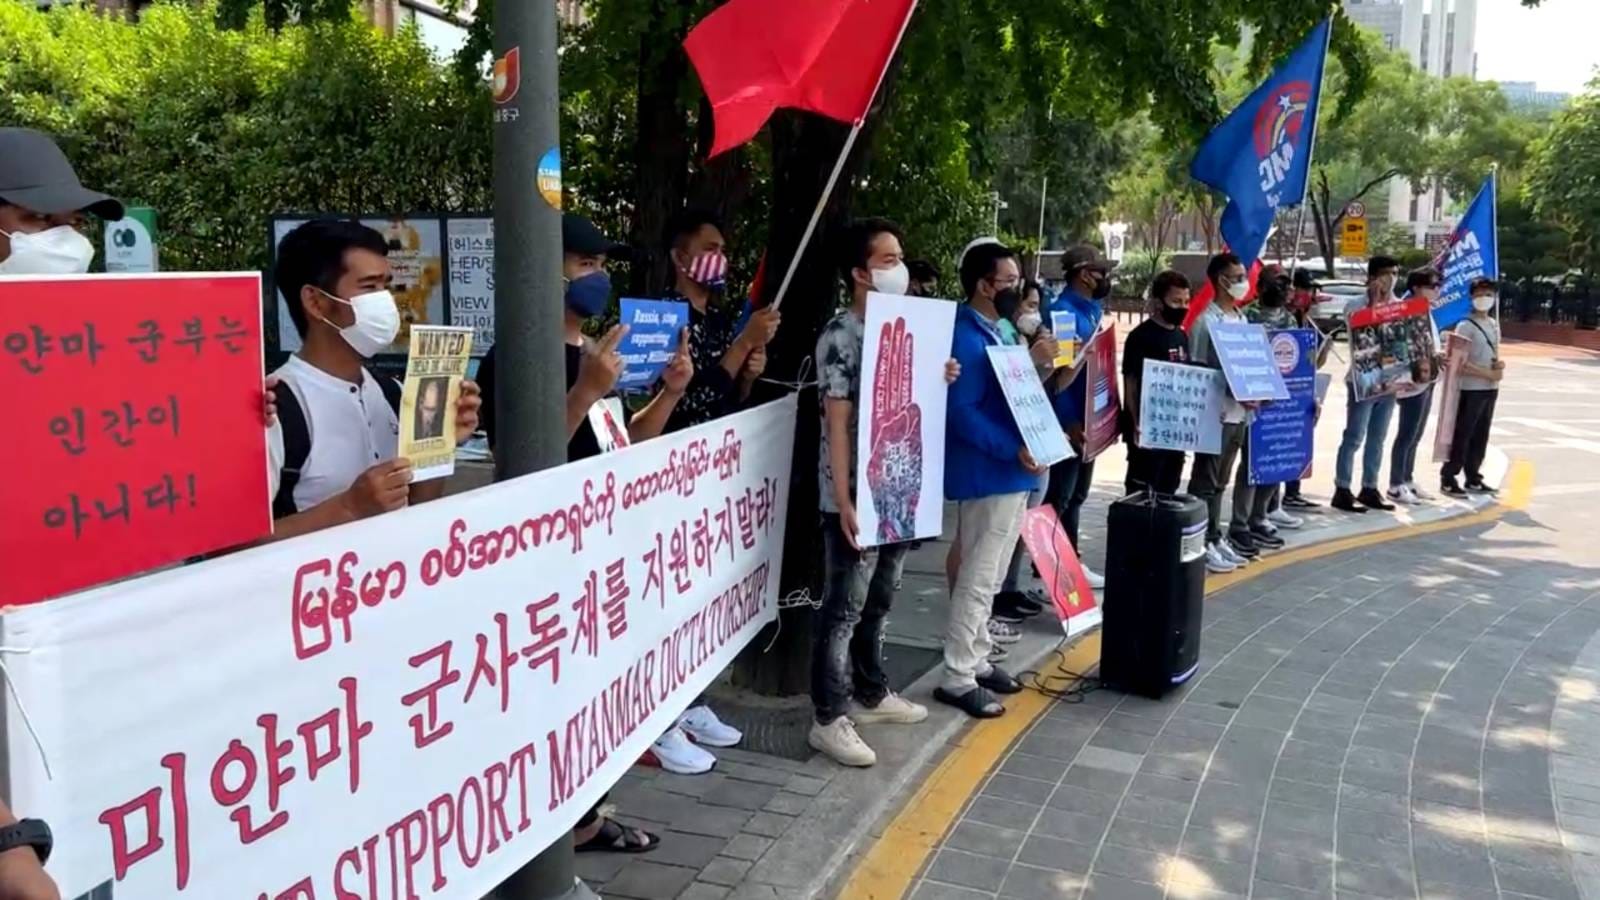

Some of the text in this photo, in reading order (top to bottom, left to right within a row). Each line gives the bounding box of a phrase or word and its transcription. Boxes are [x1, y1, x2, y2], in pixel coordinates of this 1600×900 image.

[452, 271, 472, 284] RE
[4, 315, 248, 375] 얀마 군부는
[418, 332, 465, 356] WANTED
[48, 394, 181, 455] 인간이
[43, 472, 197, 540] 아니다!
[292, 551, 407, 660] မြန်မာ
[98, 477, 778, 892] 미얀마 군사독재를 지원하지말라!
[334, 557, 770, 900] SUPPORT MYANMAR DICTATORSHIP!
